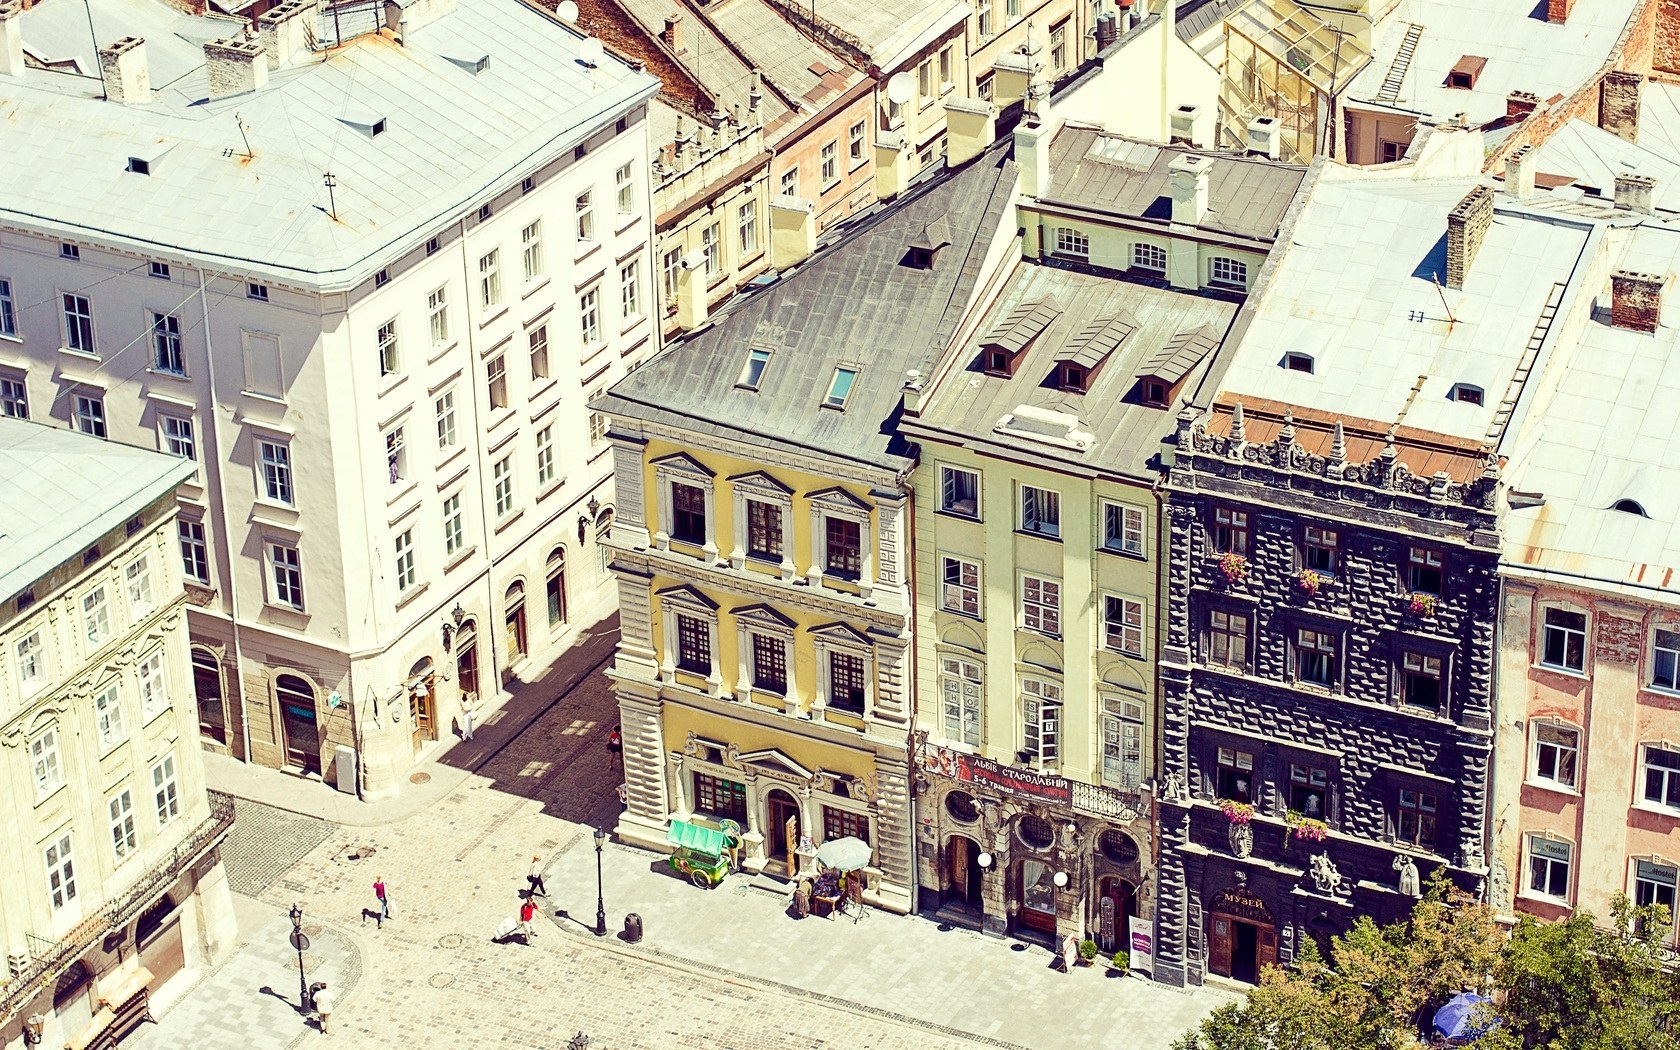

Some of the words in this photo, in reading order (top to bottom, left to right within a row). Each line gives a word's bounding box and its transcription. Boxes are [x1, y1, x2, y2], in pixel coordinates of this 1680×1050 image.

[973, 759, 998, 773] ЛЬВІВ
[1002, 766, 1068, 789] СТАРОДАВНІЙ
[973, 775, 987, 785] 5-6
[989, 780, 1014, 794] травня
[1224, 893, 1263, 909] МУЗЕЙ
